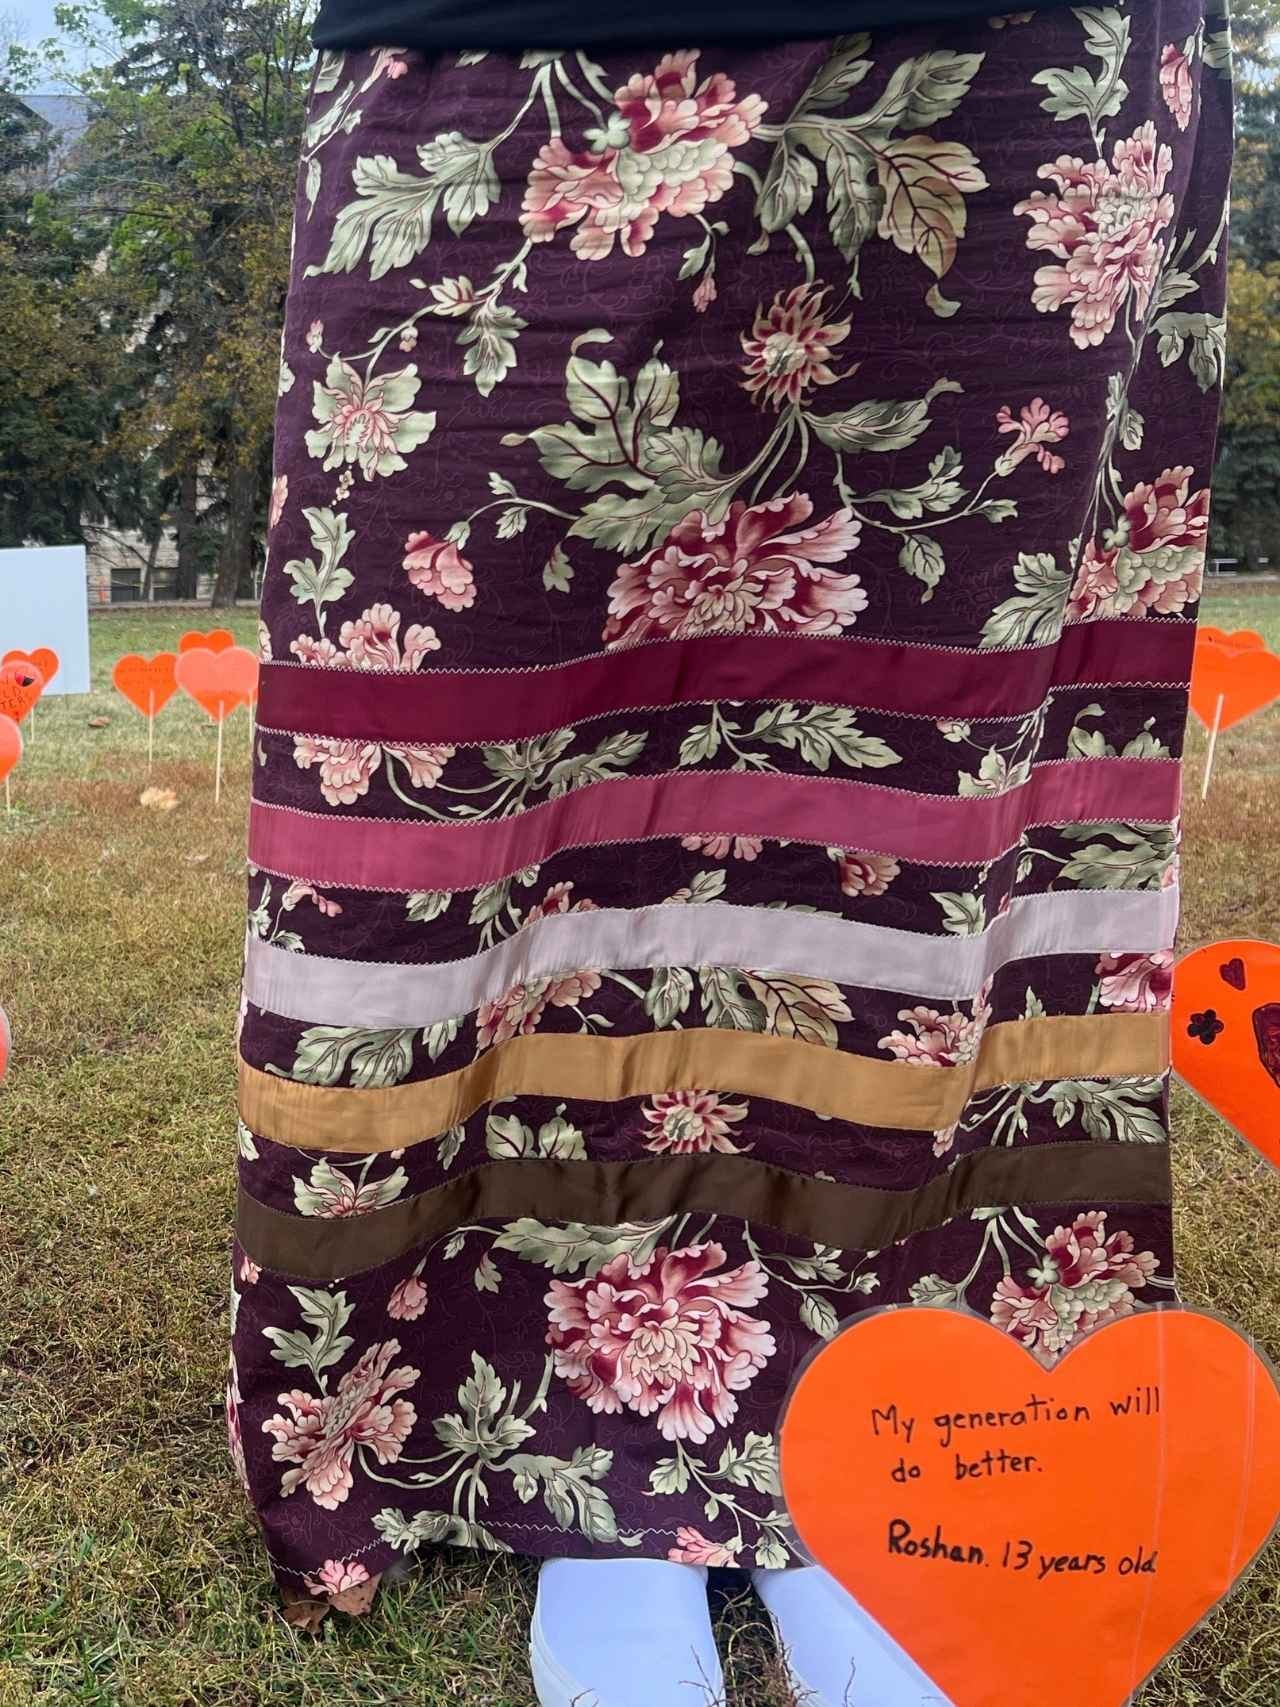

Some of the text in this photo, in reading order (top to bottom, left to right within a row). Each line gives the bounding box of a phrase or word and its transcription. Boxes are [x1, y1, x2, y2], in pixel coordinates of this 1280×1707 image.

[872, 1386, 1160, 1448] My generation will
[891, 1448, 1043, 1483] do better.
[1001, 1540, 1034, 1570] 13
[1039, 1551, 1107, 1580] years
[1118, 1545, 1159, 1575] old
